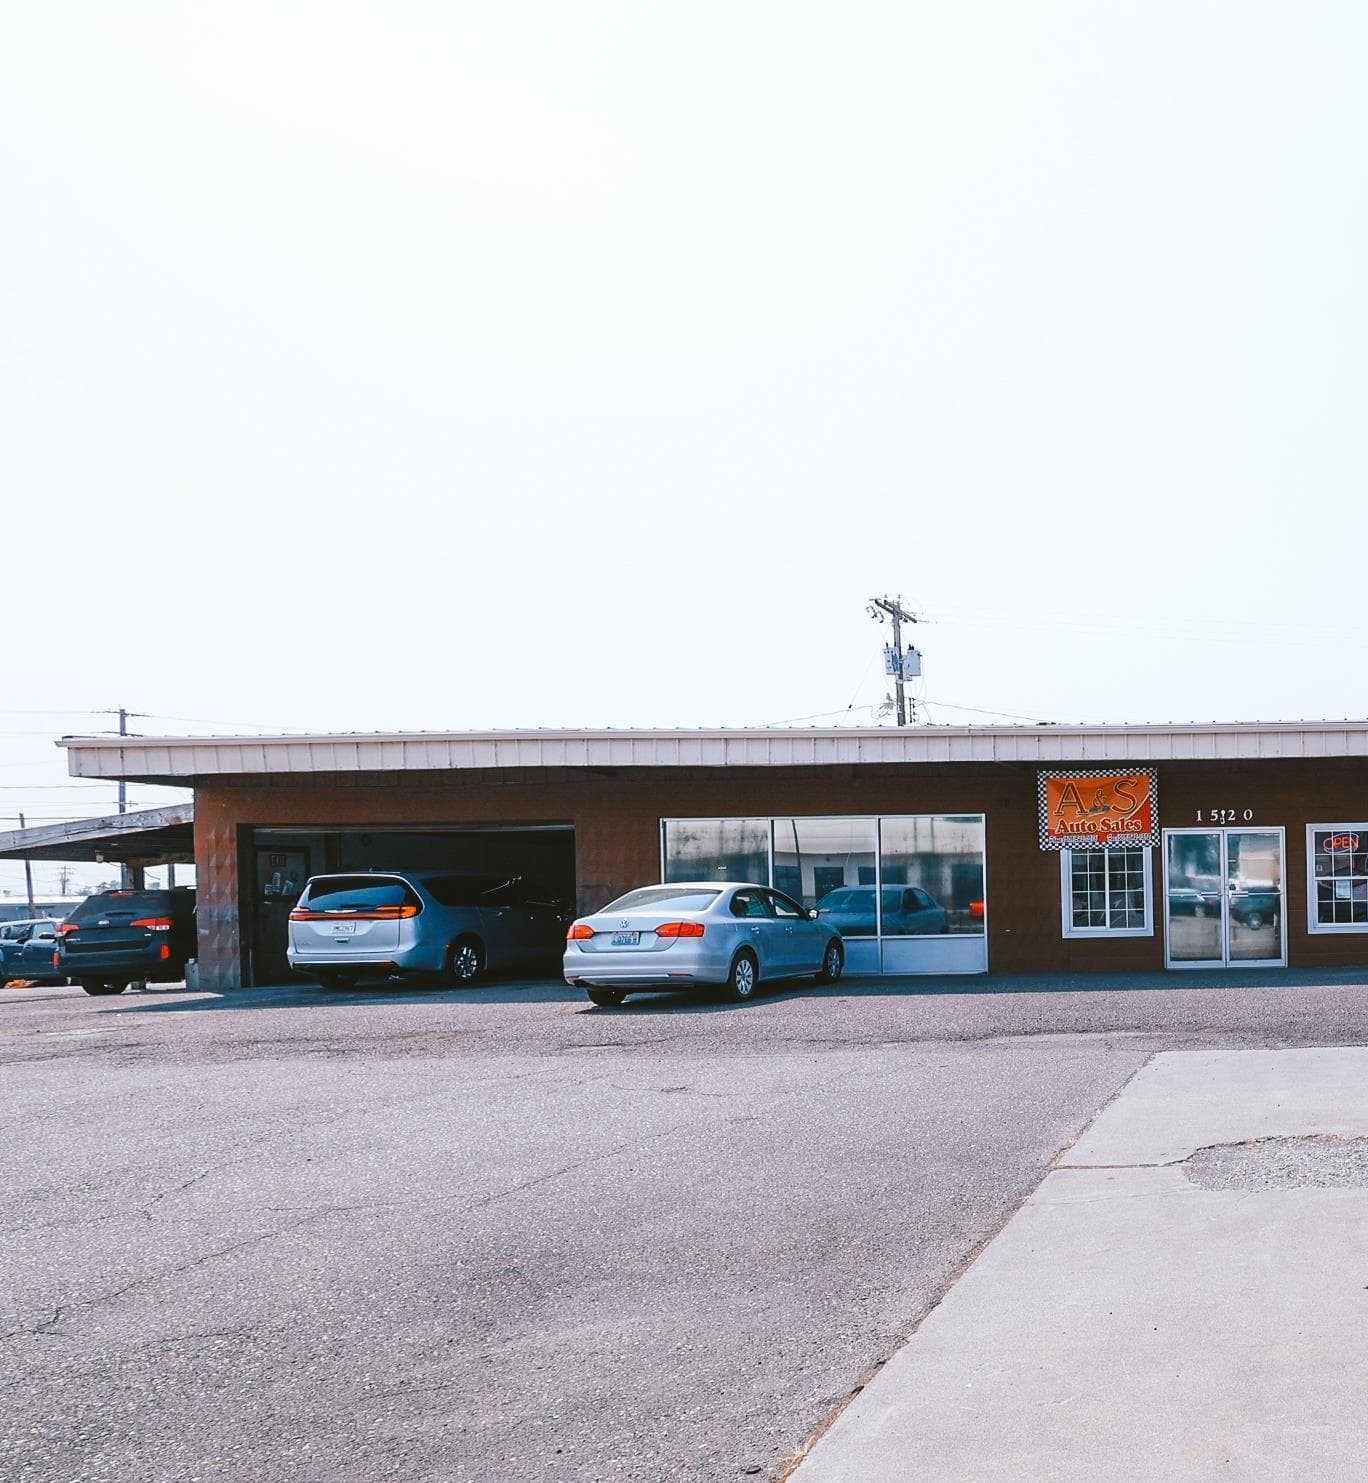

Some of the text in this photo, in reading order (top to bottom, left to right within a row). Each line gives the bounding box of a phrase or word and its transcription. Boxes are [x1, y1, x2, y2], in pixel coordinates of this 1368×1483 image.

[1053, 779, 1138, 816] A & S
[1196, 809, 1253, 822] 1520
[1055, 817, 1142, 835] Auto Sales
[1323, 836, 1359, 850] OPEN
